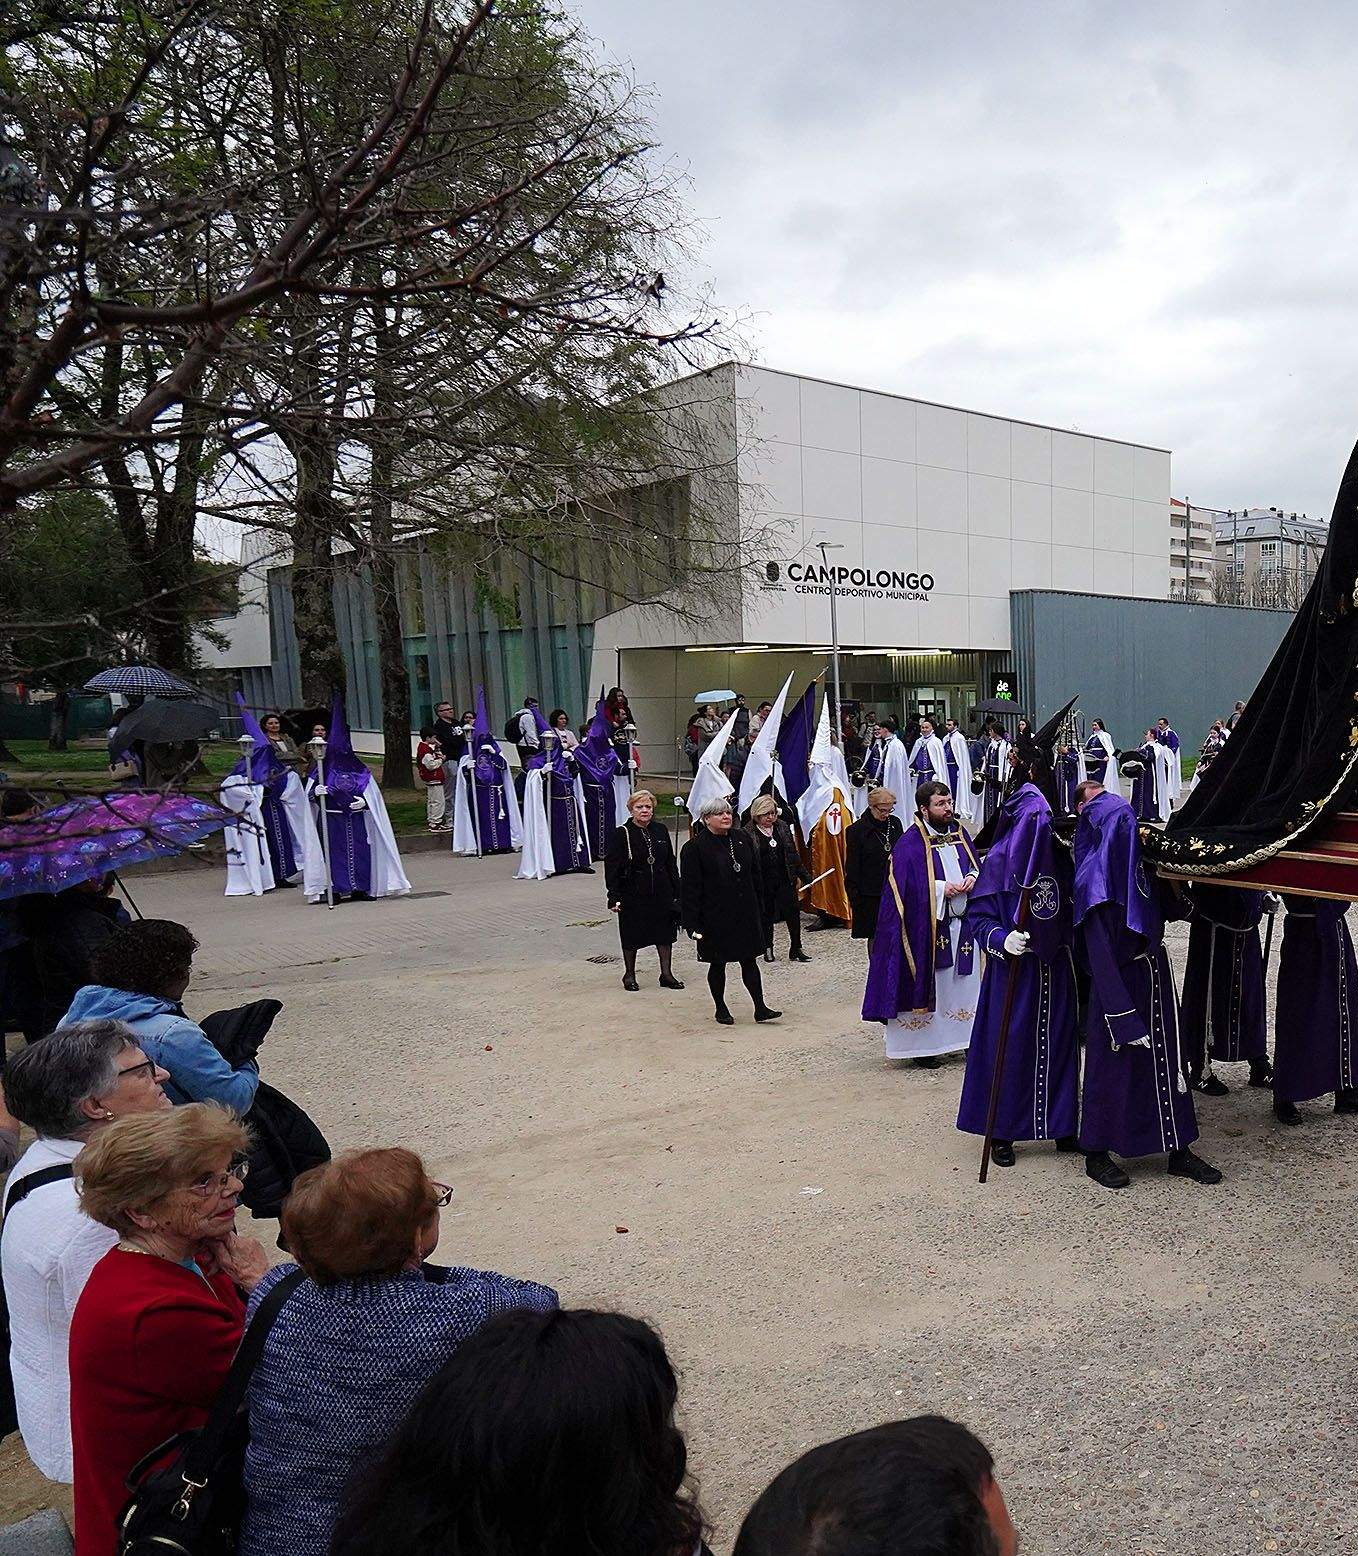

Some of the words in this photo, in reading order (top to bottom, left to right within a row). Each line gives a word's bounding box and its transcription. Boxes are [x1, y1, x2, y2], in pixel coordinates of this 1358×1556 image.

[788, 563, 934, 591] CAMPOLONGO
[794, 584, 832, 596] CENTRO
[834, 586, 884, 599] DEPORTIVO
[886, 591, 930, 602] MUNICIPAL
